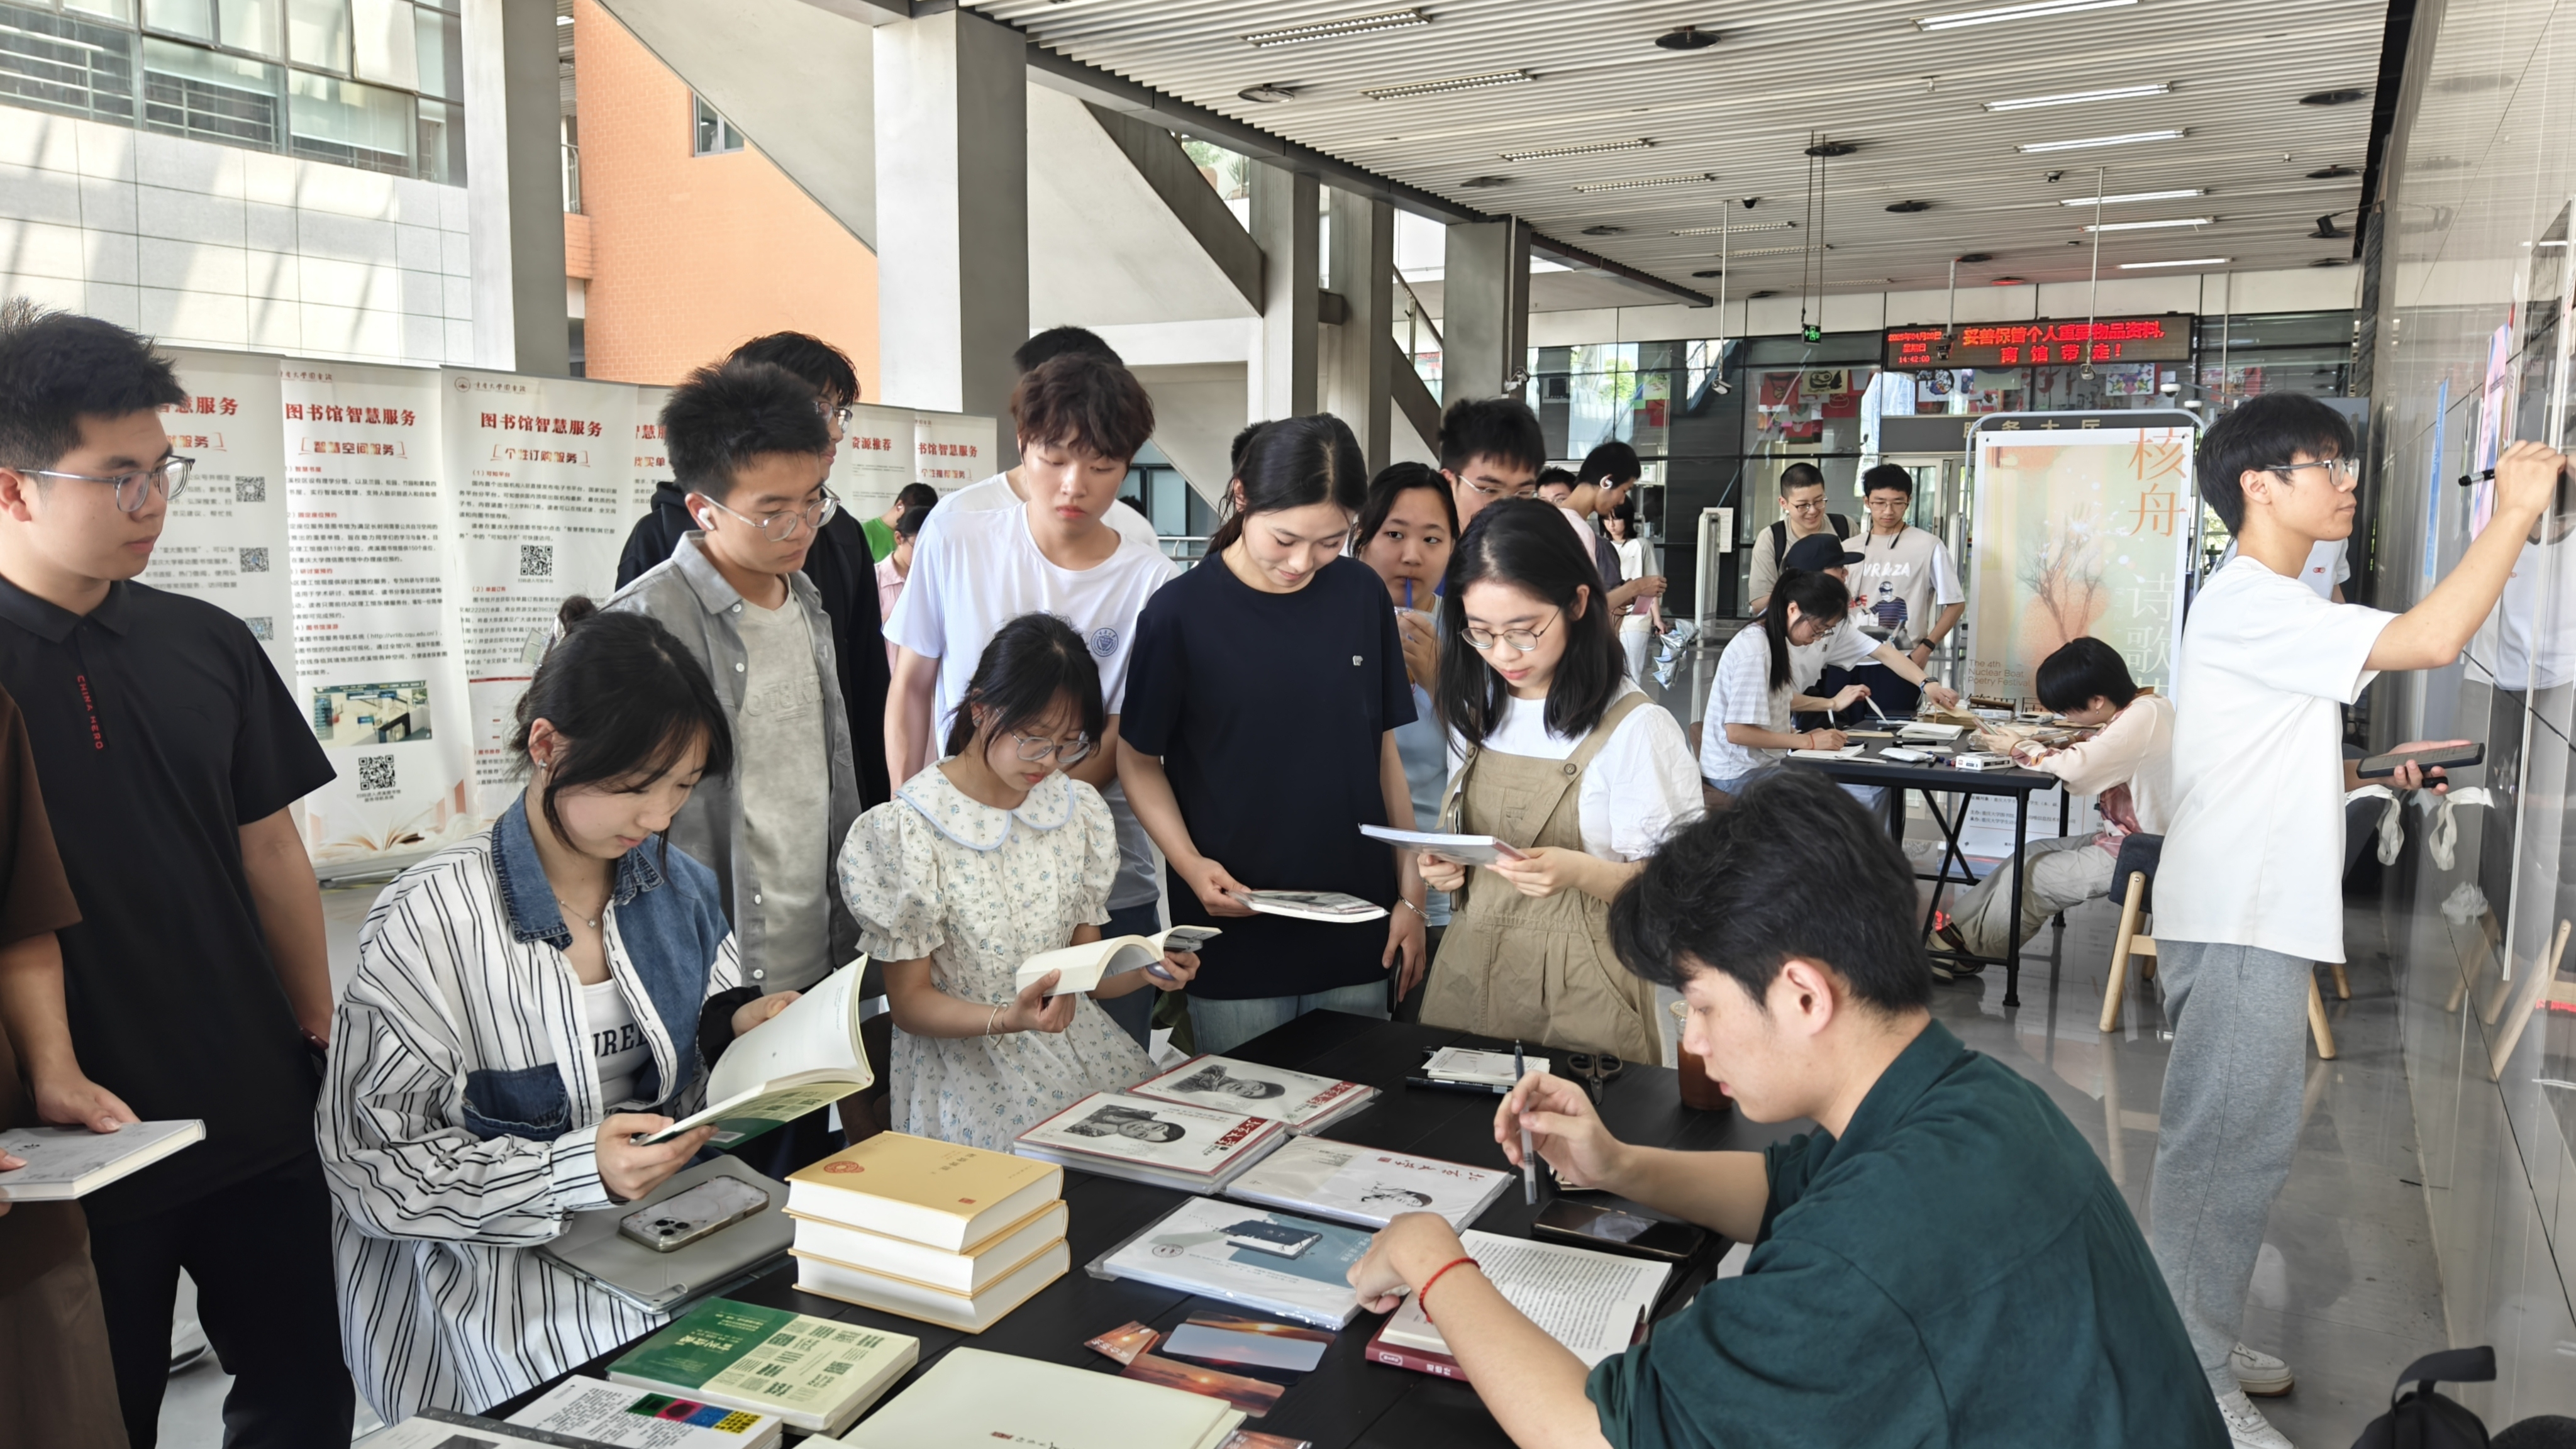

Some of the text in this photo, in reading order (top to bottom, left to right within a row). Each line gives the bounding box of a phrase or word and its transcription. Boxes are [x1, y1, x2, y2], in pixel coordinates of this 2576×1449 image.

[1902, 343, 1926, 352] 星期日
[285, 402, 416, 426] 图书馆智慧服务
[481, 412, 602, 437] 图书馆智慧服务
[314, 441, 394, 456] 智慧空间服务
[505, 448, 577, 464] 个性订购服务
[2128, 428, 2189, 537] 核舟
[1968, 676, 2031, 687] Poetry Festival
[77, 675, 104, 749] CHINA HERO
